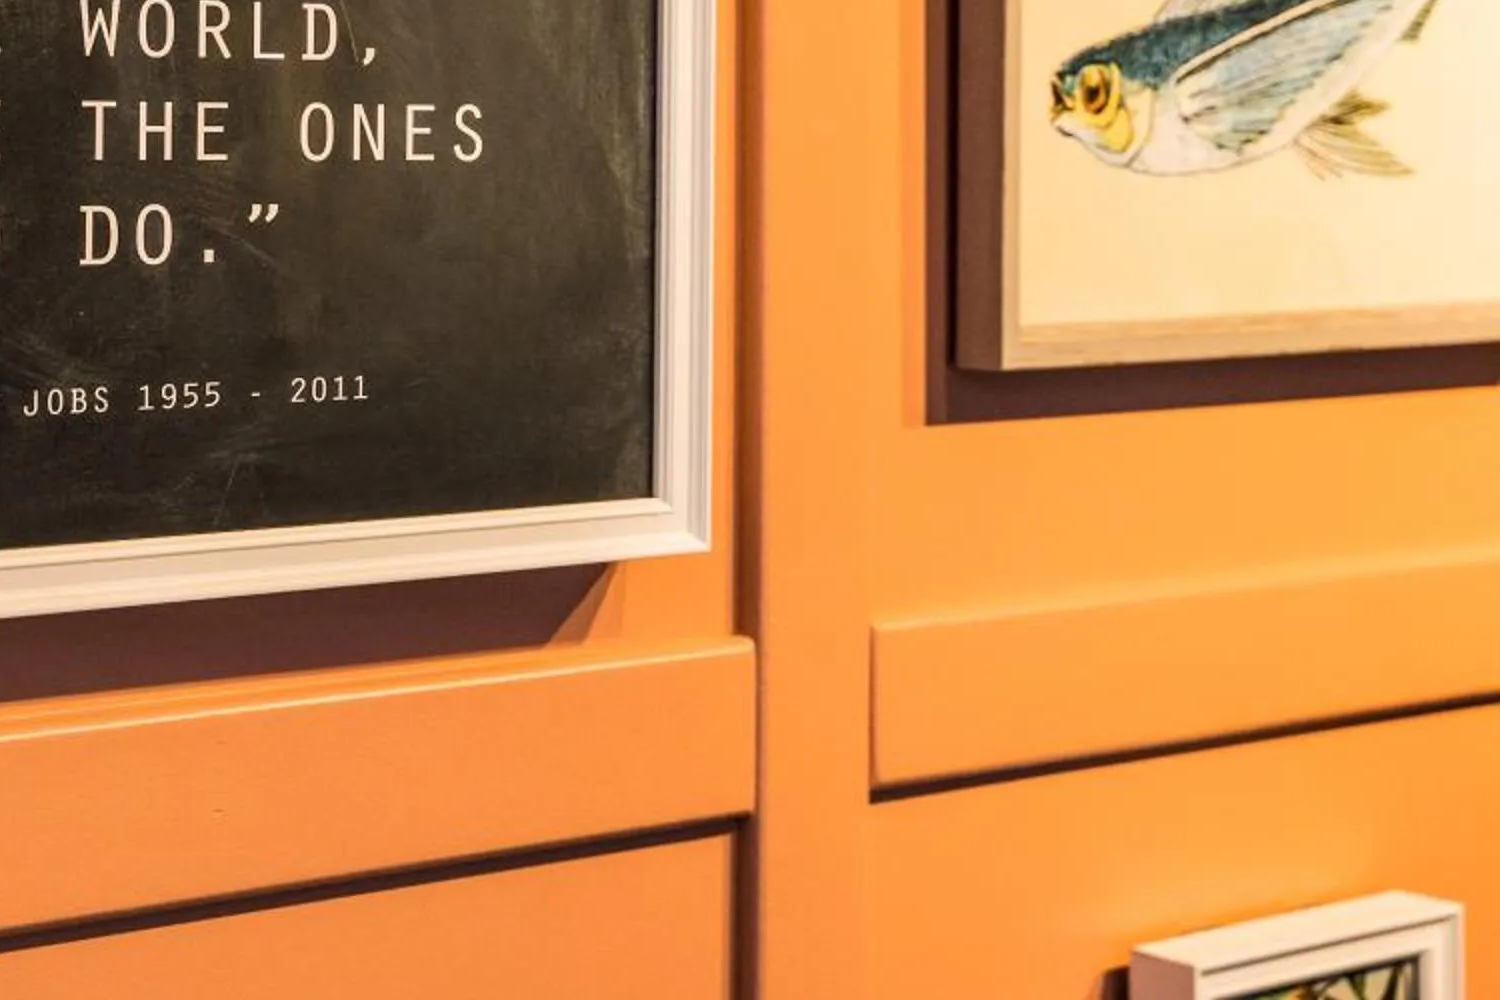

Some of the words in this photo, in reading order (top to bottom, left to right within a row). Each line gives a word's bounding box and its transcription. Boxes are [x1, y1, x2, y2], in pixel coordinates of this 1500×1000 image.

[81, 100, 229, 161] THE
[299, 101, 485, 163] ONES
[79, 203, 279, 266] DO.”
[23, 386, 109, 417] JOBS
[138, 381, 221, 411] 1955
[291, 375, 369, 403] 2011
